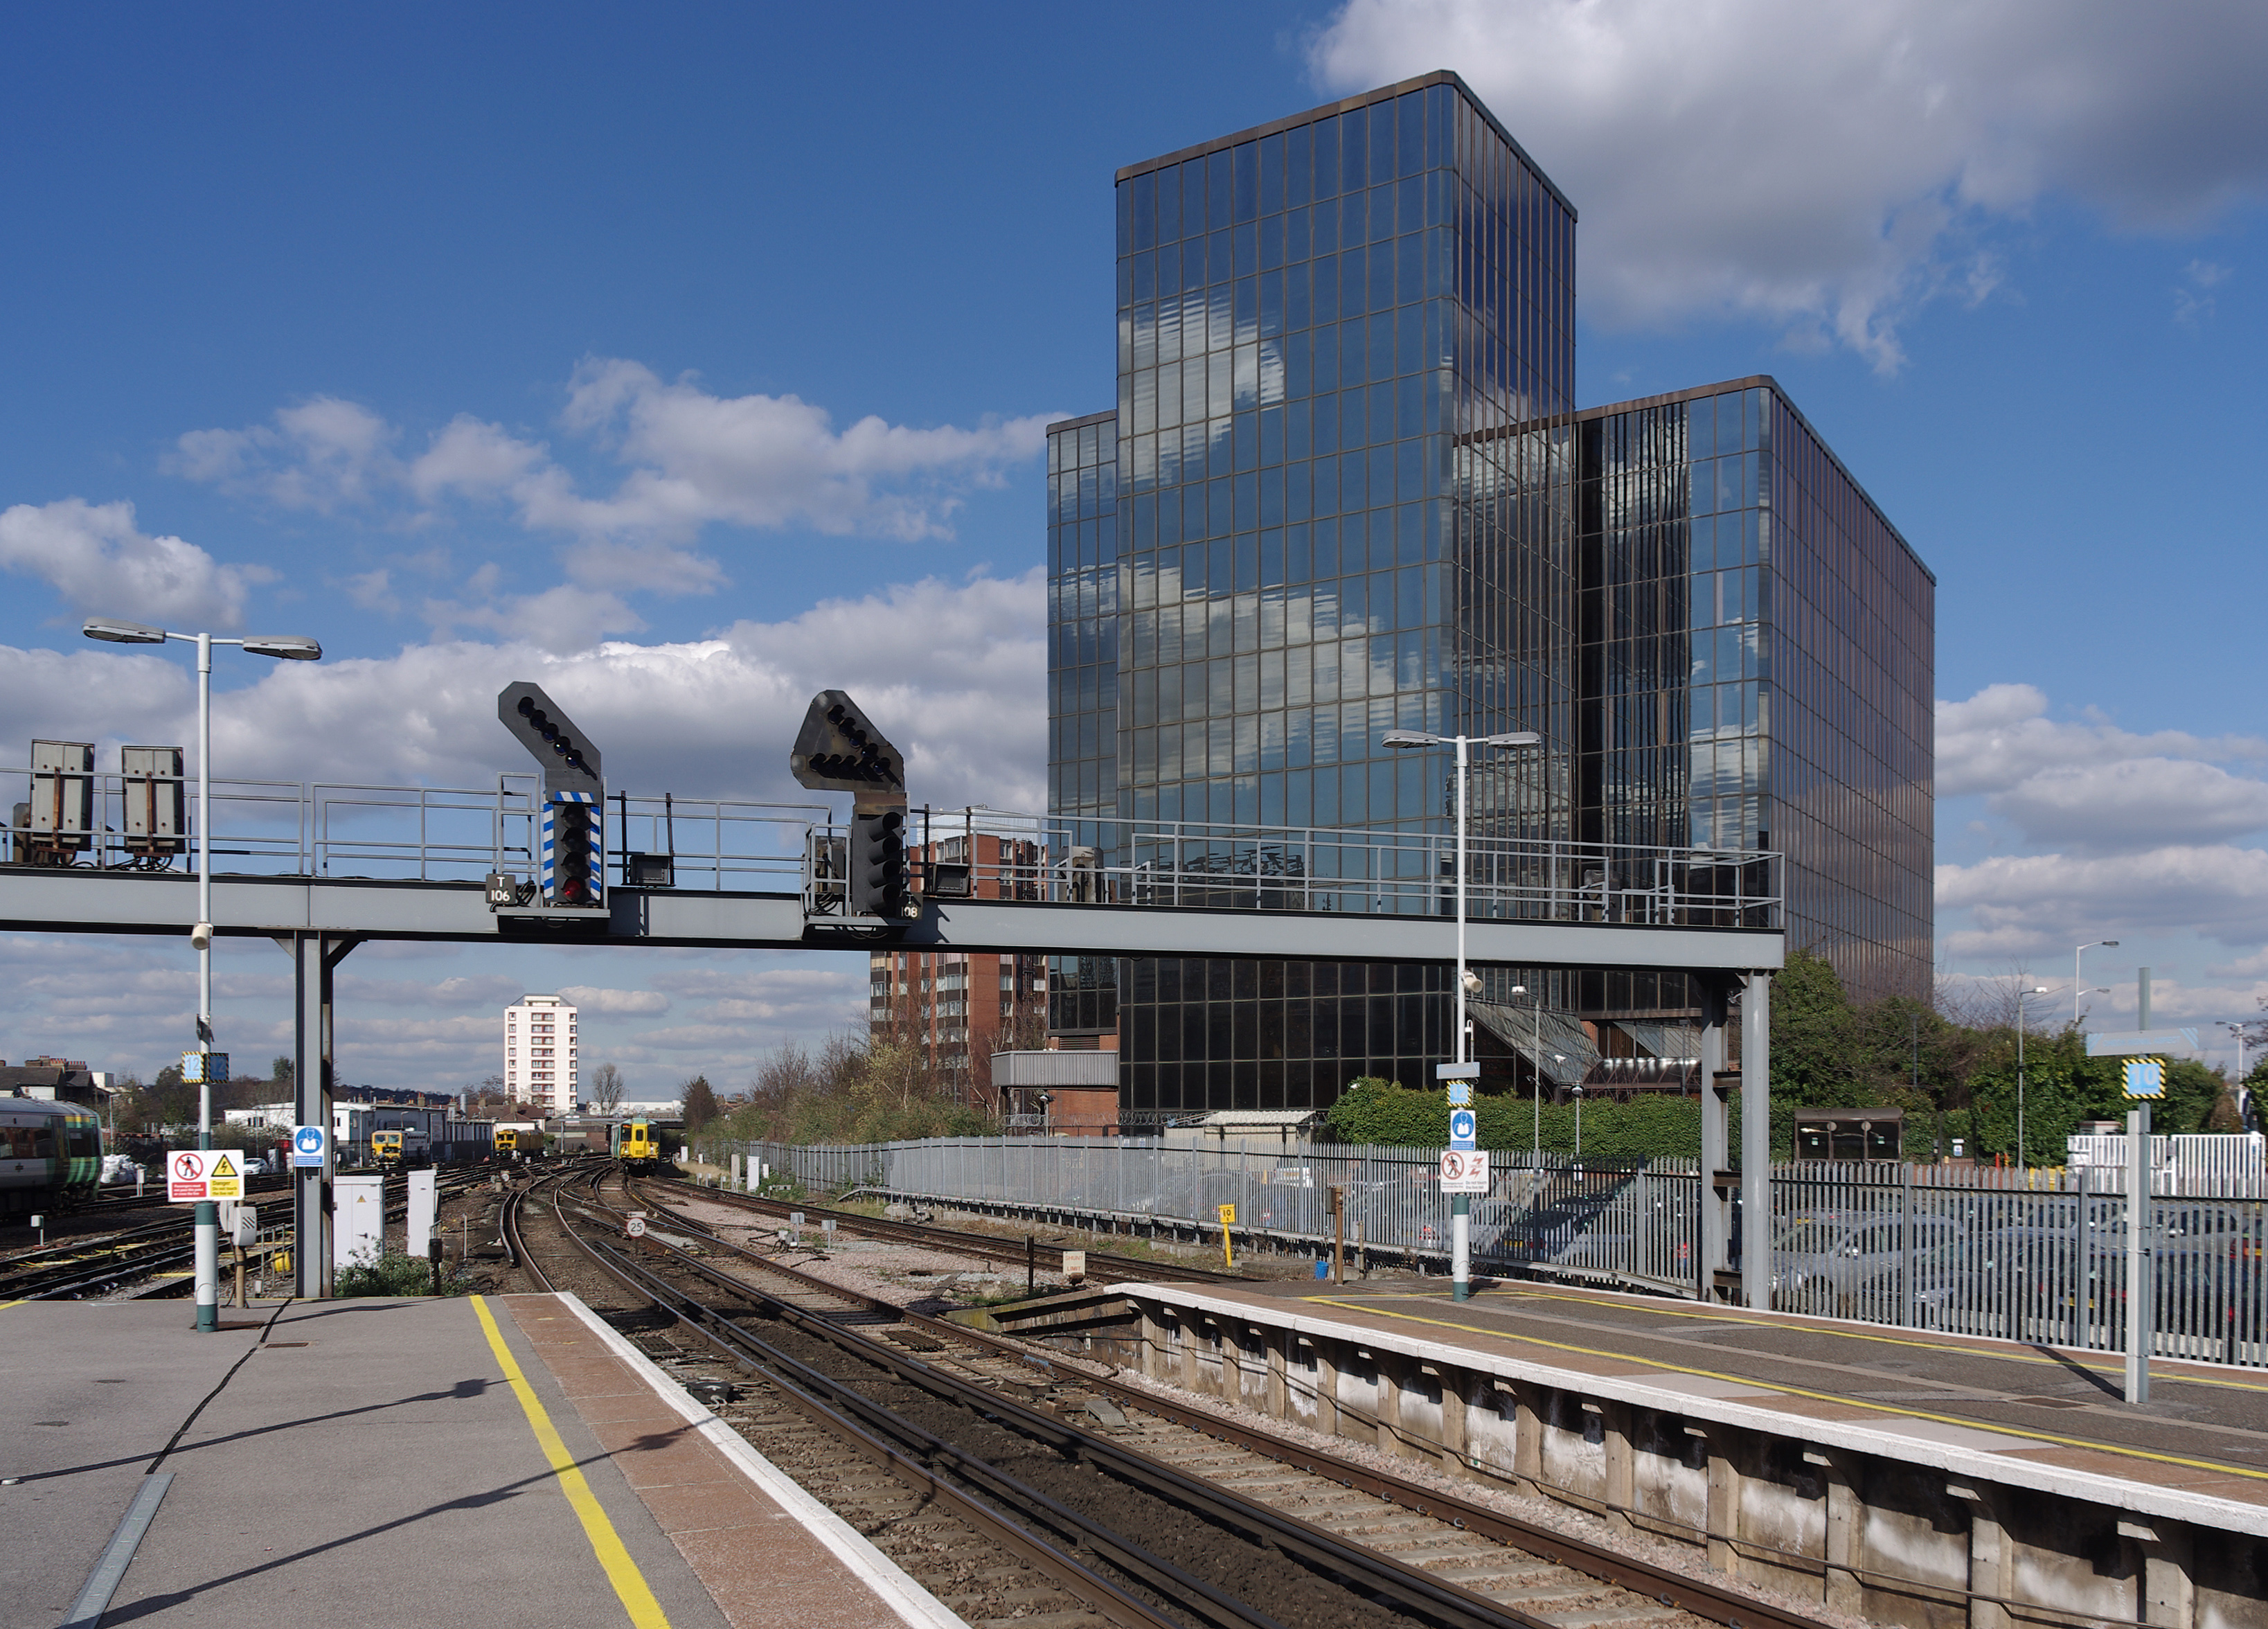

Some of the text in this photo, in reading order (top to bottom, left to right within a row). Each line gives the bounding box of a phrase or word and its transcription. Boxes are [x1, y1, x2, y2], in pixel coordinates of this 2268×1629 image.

[496, 876, 506, 887] T
[491, 889, 511, 902] 106
[186, 1057, 200, 1071] 12
[2131, 1066, 2157, 1085] 10
[1452, 1086, 1467, 1098] 12
[1223, 1209, 1231, 1217] 10
[630, 1222, 643, 1232] 25
